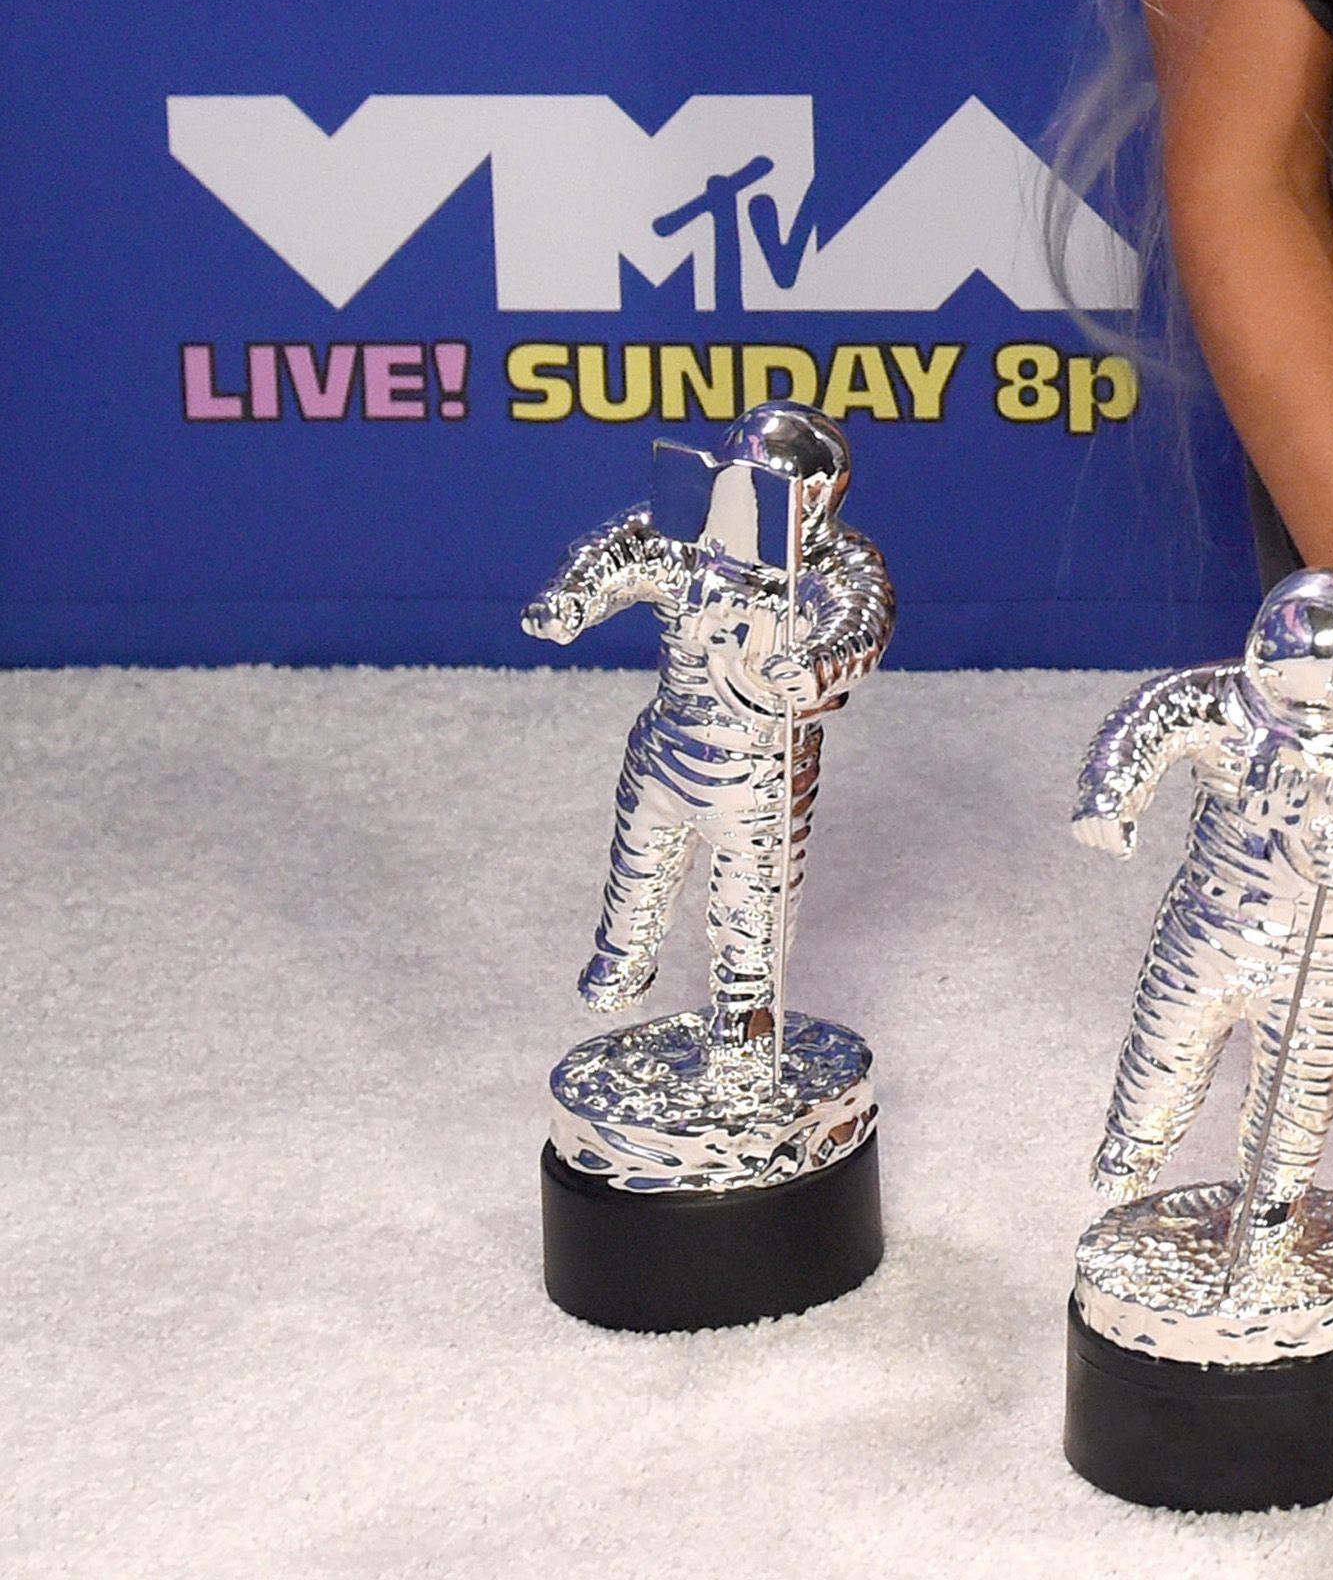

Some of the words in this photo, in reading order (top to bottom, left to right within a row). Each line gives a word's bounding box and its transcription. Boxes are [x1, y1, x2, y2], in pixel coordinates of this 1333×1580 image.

[166, 94, 1140, 312] VMA
[180, 341, 470, 422] LIVE!
[506, 342, 963, 422] SUNDAY
[993, 342, 1141, 434] 8p
